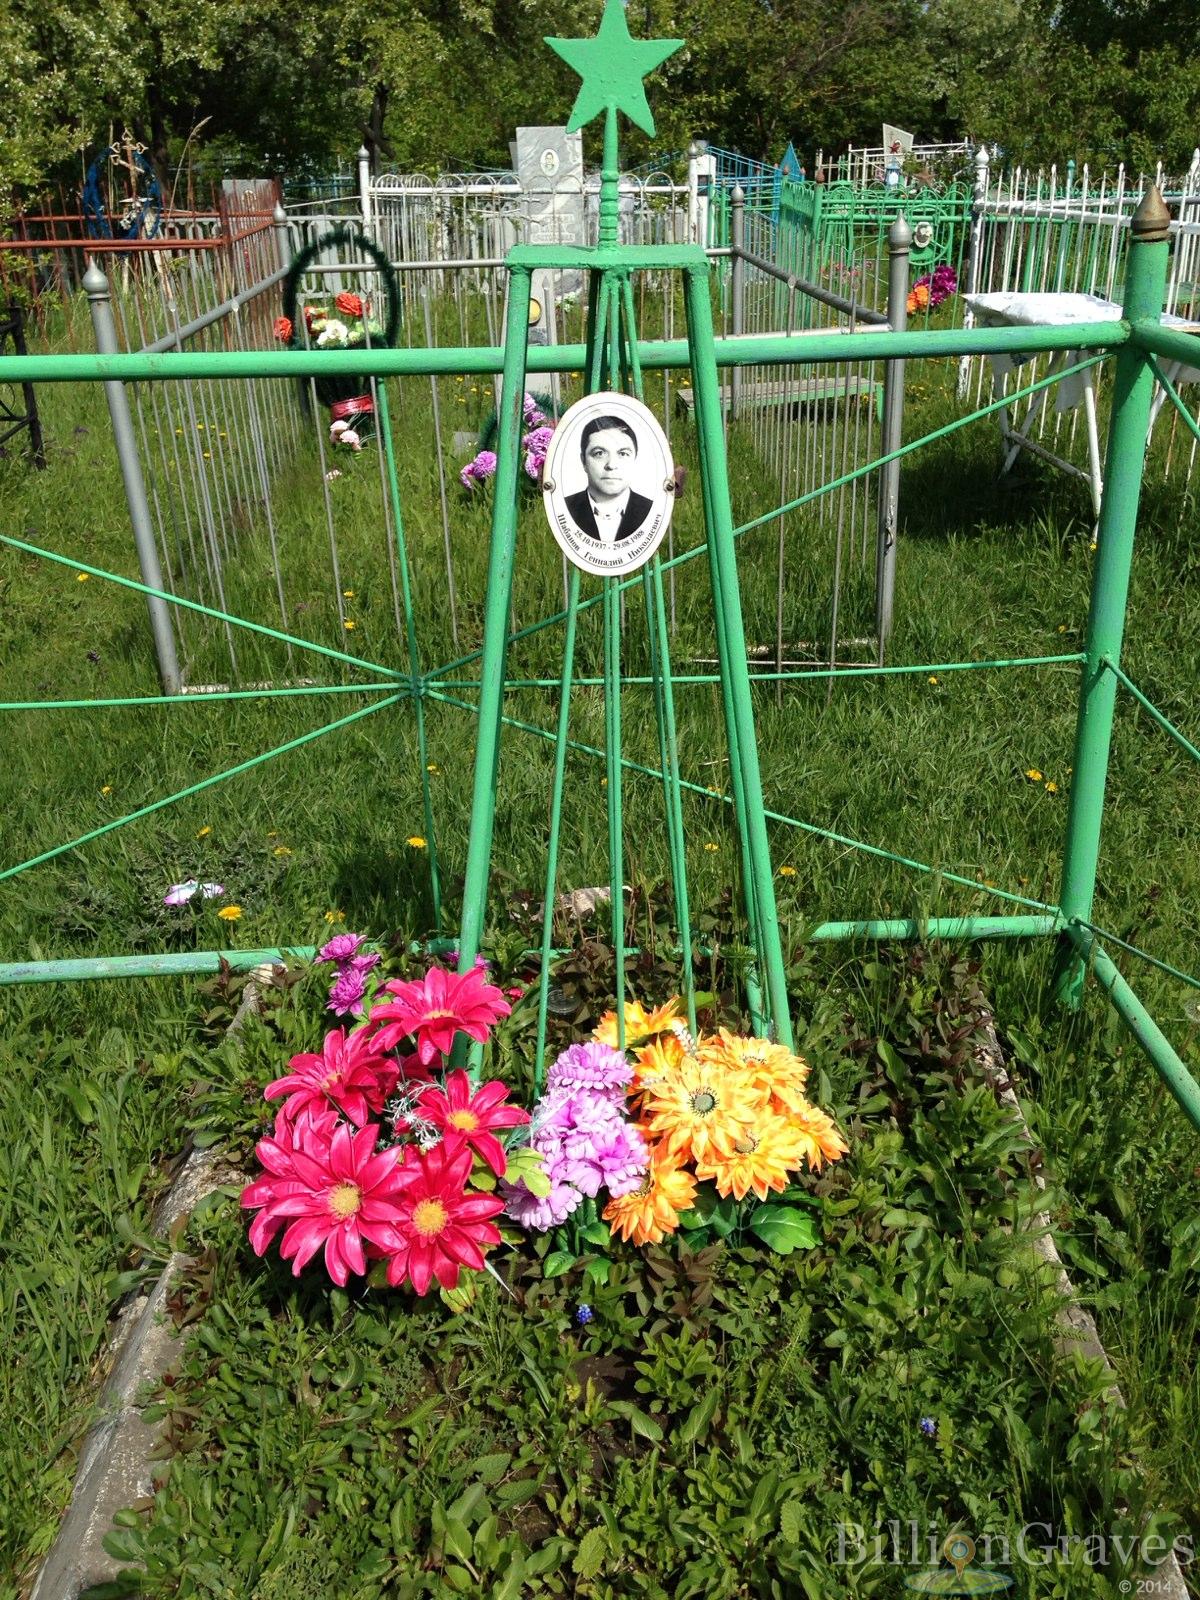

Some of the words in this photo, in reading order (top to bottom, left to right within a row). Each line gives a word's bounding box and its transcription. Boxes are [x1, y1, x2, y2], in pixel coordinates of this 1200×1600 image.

[557, 514, 581, 552] Шабанов
[584, 551, 623, 566] Геннадий
[627, 514, 662, 560] Николаевич
